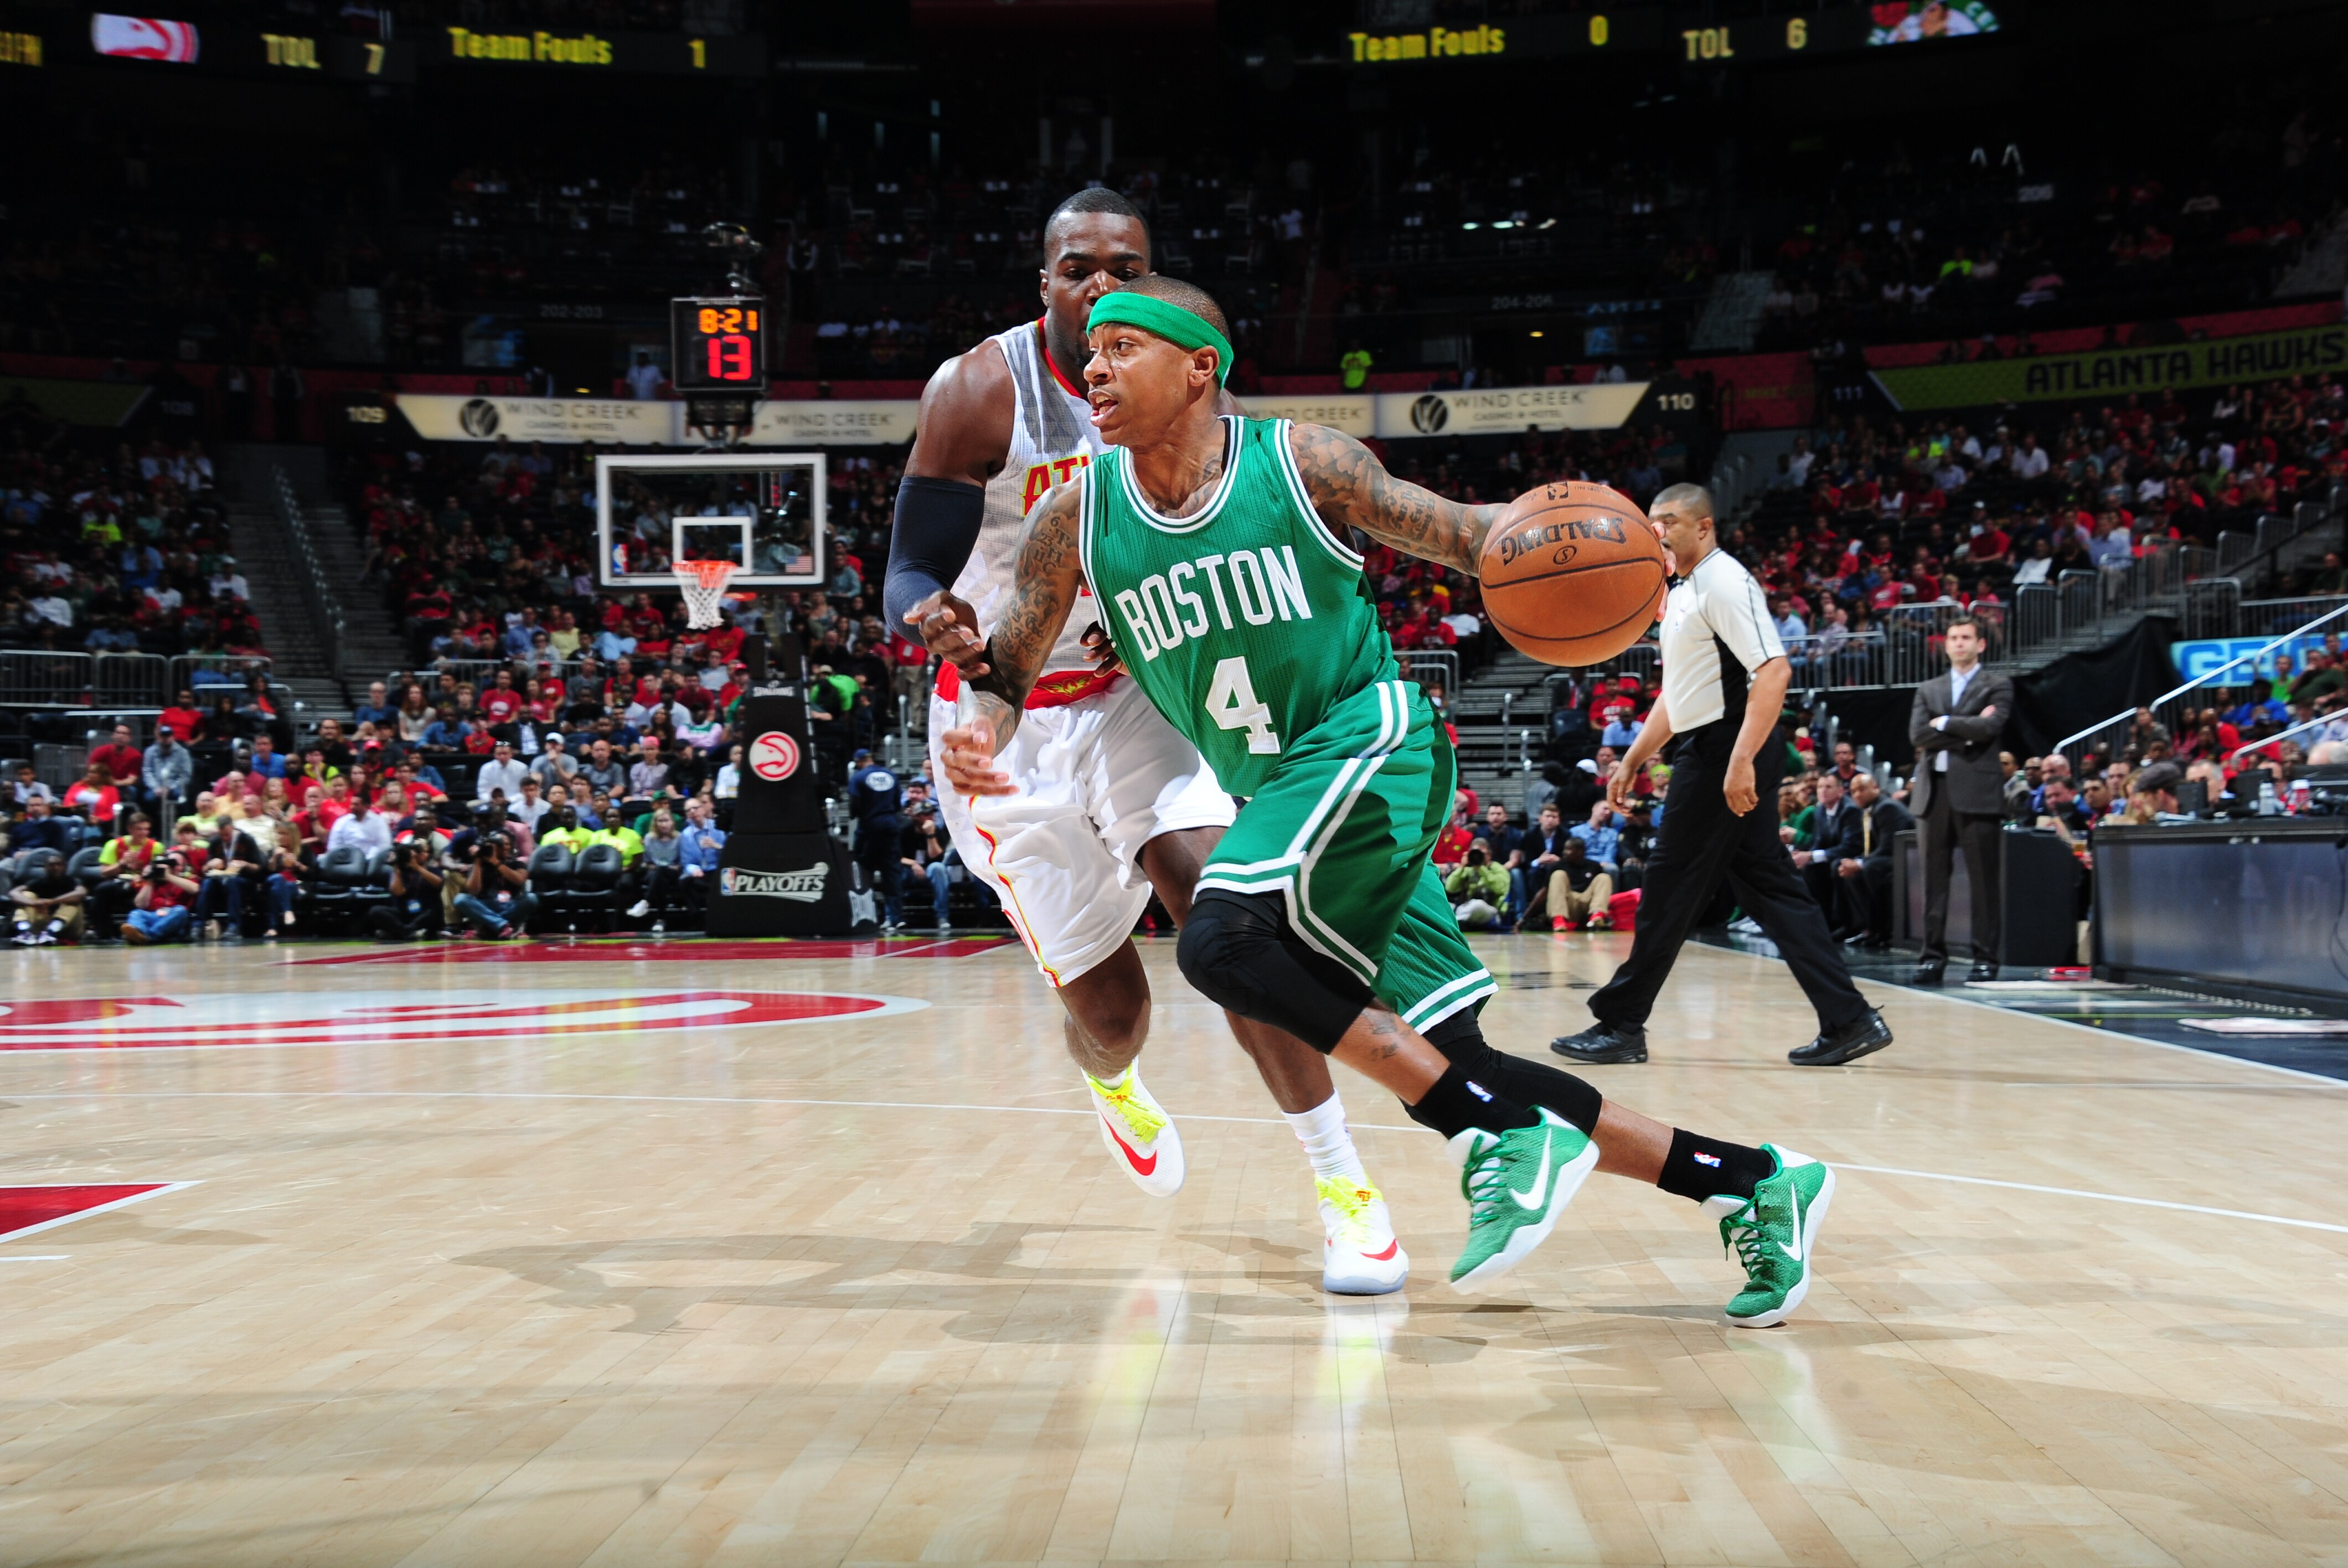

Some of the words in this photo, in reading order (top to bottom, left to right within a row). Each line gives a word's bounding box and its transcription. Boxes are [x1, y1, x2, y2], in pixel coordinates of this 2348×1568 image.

[446, 27, 531, 61] Team
[533, 30, 613, 65] Fouls
[1348, 32, 1427, 63] Team
[1430, 23, 1506, 57] Fouls
[1588, 14, 1608, 46] 0
[1681, 27, 1735, 61] TOL
[1785, 18, 1808, 50] 6
[260, 33, 322, 70] TOL
[363, 42, 385, 75] 7
[687, 38, 706, 69] 1
[698, 308, 758, 334] 8:21
[707, 335, 752, 380] 13
[2027, 352, 2192, 394] ATLANTA
[2208, 331, 2345, 378] HAWKS
[1453, 394, 1510, 408] WIND
[1516, 391, 1583, 407] CREEK
[1655, 392, 1696, 411] 110
[1833, 385, 1864, 401] 111
[345, 405, 388, 424] 109
[505, 401, 563, 417] WIND
[572, 404, 640, 420] CREEK
[775, 414, 826, 426] WIND
[832, 413, 892, 426] CREEK
[1302, 408, 1360, 421] CREEK
[1498, 517, 1627, 566] SPALDING
[1114, 545, 1313, 663] BOSTON
[753, 686, 794, 698] SPALDING
[1205, 656, 1281, 754] 4
[735, 874, 825, 892] PLAYOFFS
